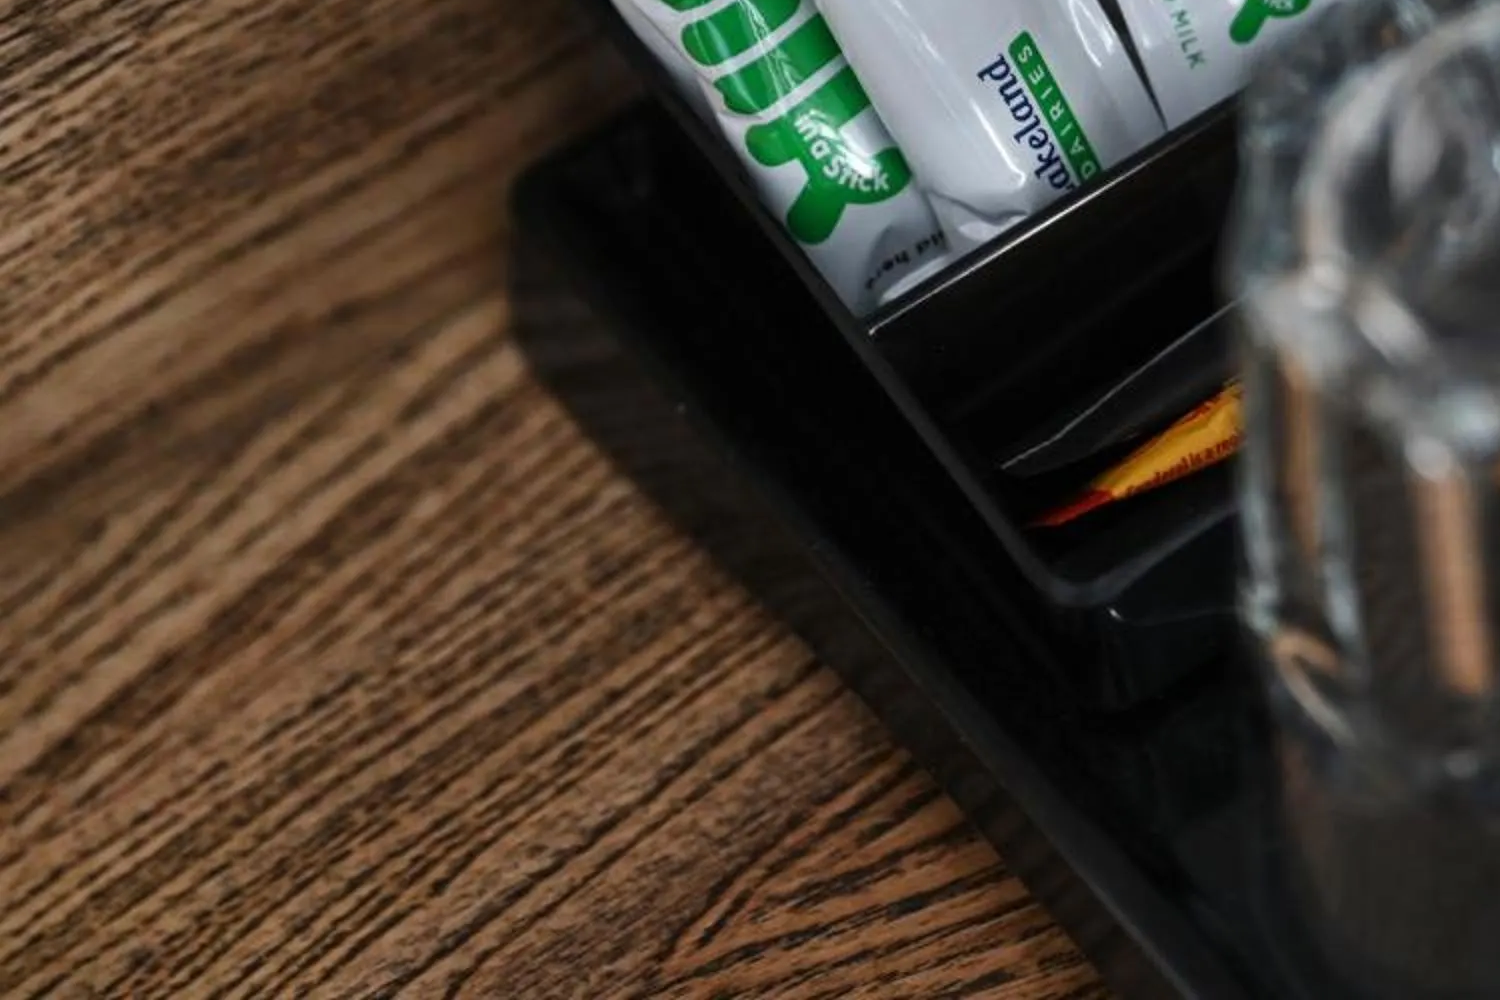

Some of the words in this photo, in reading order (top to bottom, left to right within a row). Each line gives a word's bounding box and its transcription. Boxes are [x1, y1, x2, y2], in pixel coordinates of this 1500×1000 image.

[1170, 8, 1209, 71] MILK
[976, 52, 1076, 192] akeland
[1018, 44, 1096, 181] DAIRIES
